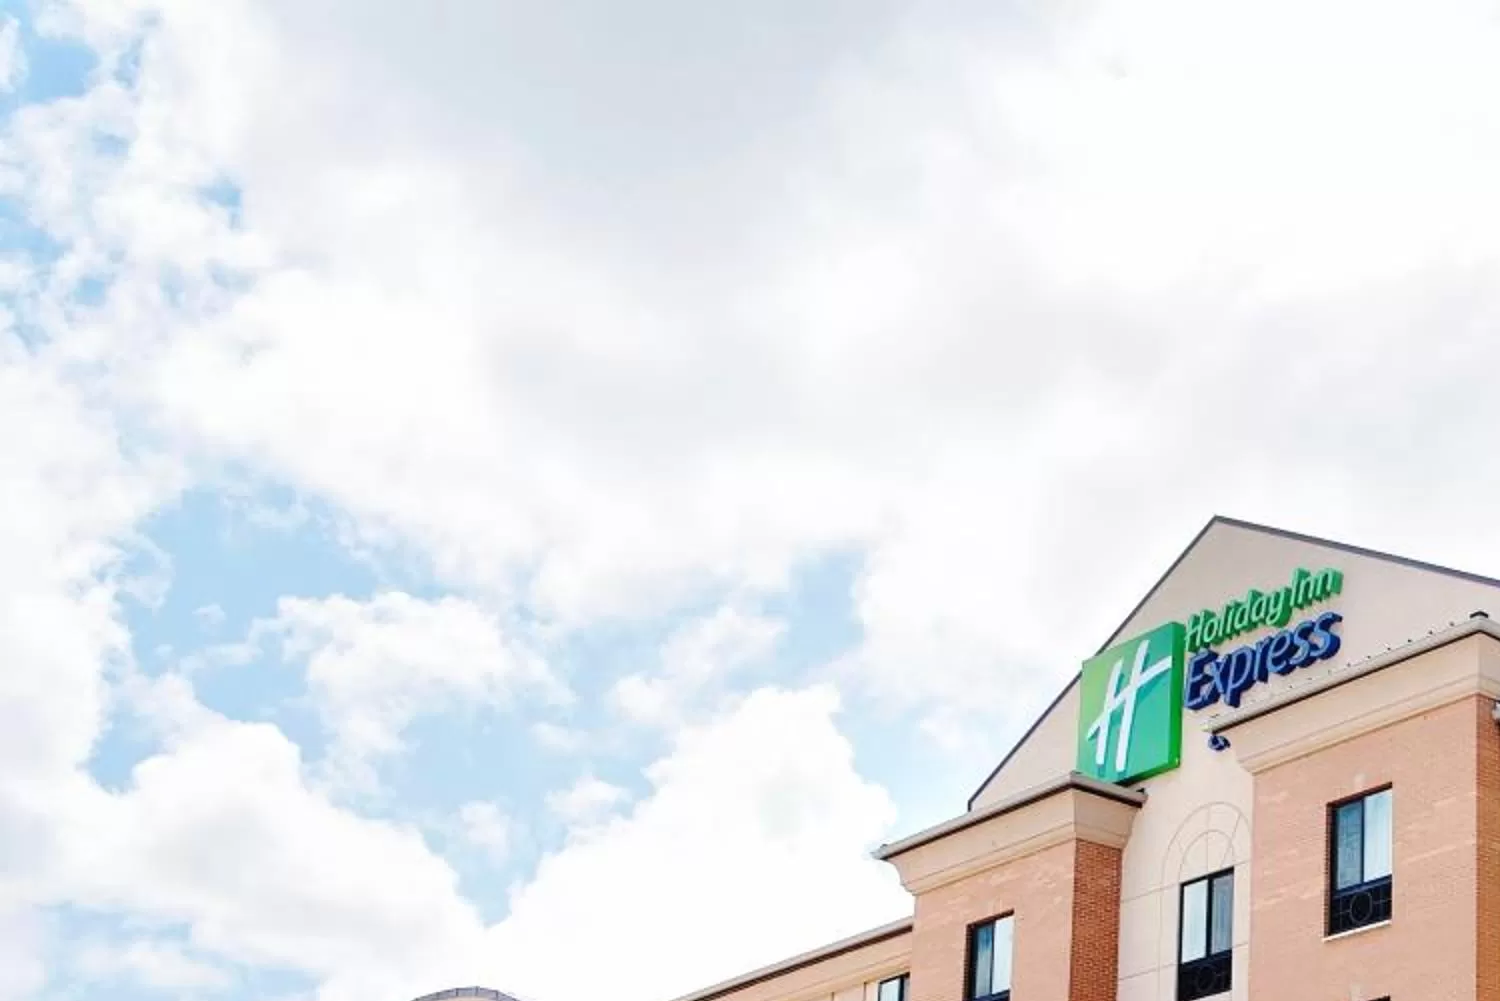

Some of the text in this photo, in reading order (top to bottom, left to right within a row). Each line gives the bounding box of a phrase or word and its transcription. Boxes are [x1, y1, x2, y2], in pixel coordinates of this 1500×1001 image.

[1184, 568, 1343, 653] Holiday Inn
[1184, 611, 1343, 710] Express
